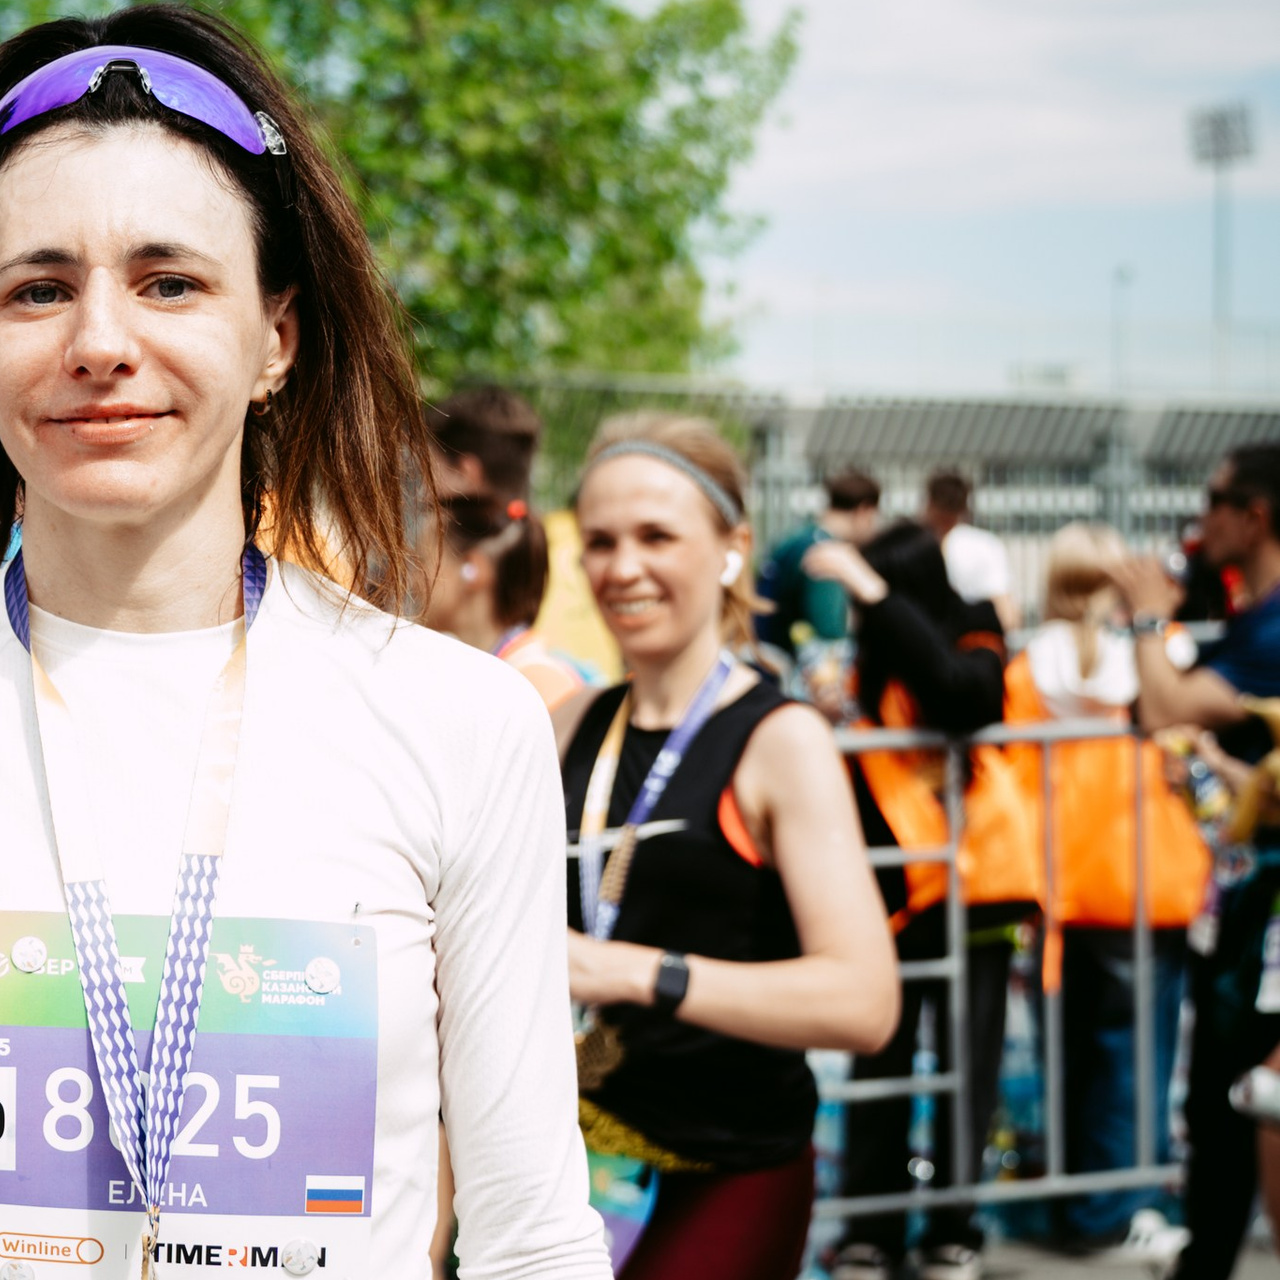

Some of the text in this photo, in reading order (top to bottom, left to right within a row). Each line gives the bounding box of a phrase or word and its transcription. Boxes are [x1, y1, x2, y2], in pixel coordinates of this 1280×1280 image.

[261, 994, 326, 1006] МАРАФОН
[42, 1067, 282, 1160] 825
[2, 1237, 72, 1257] Winline
